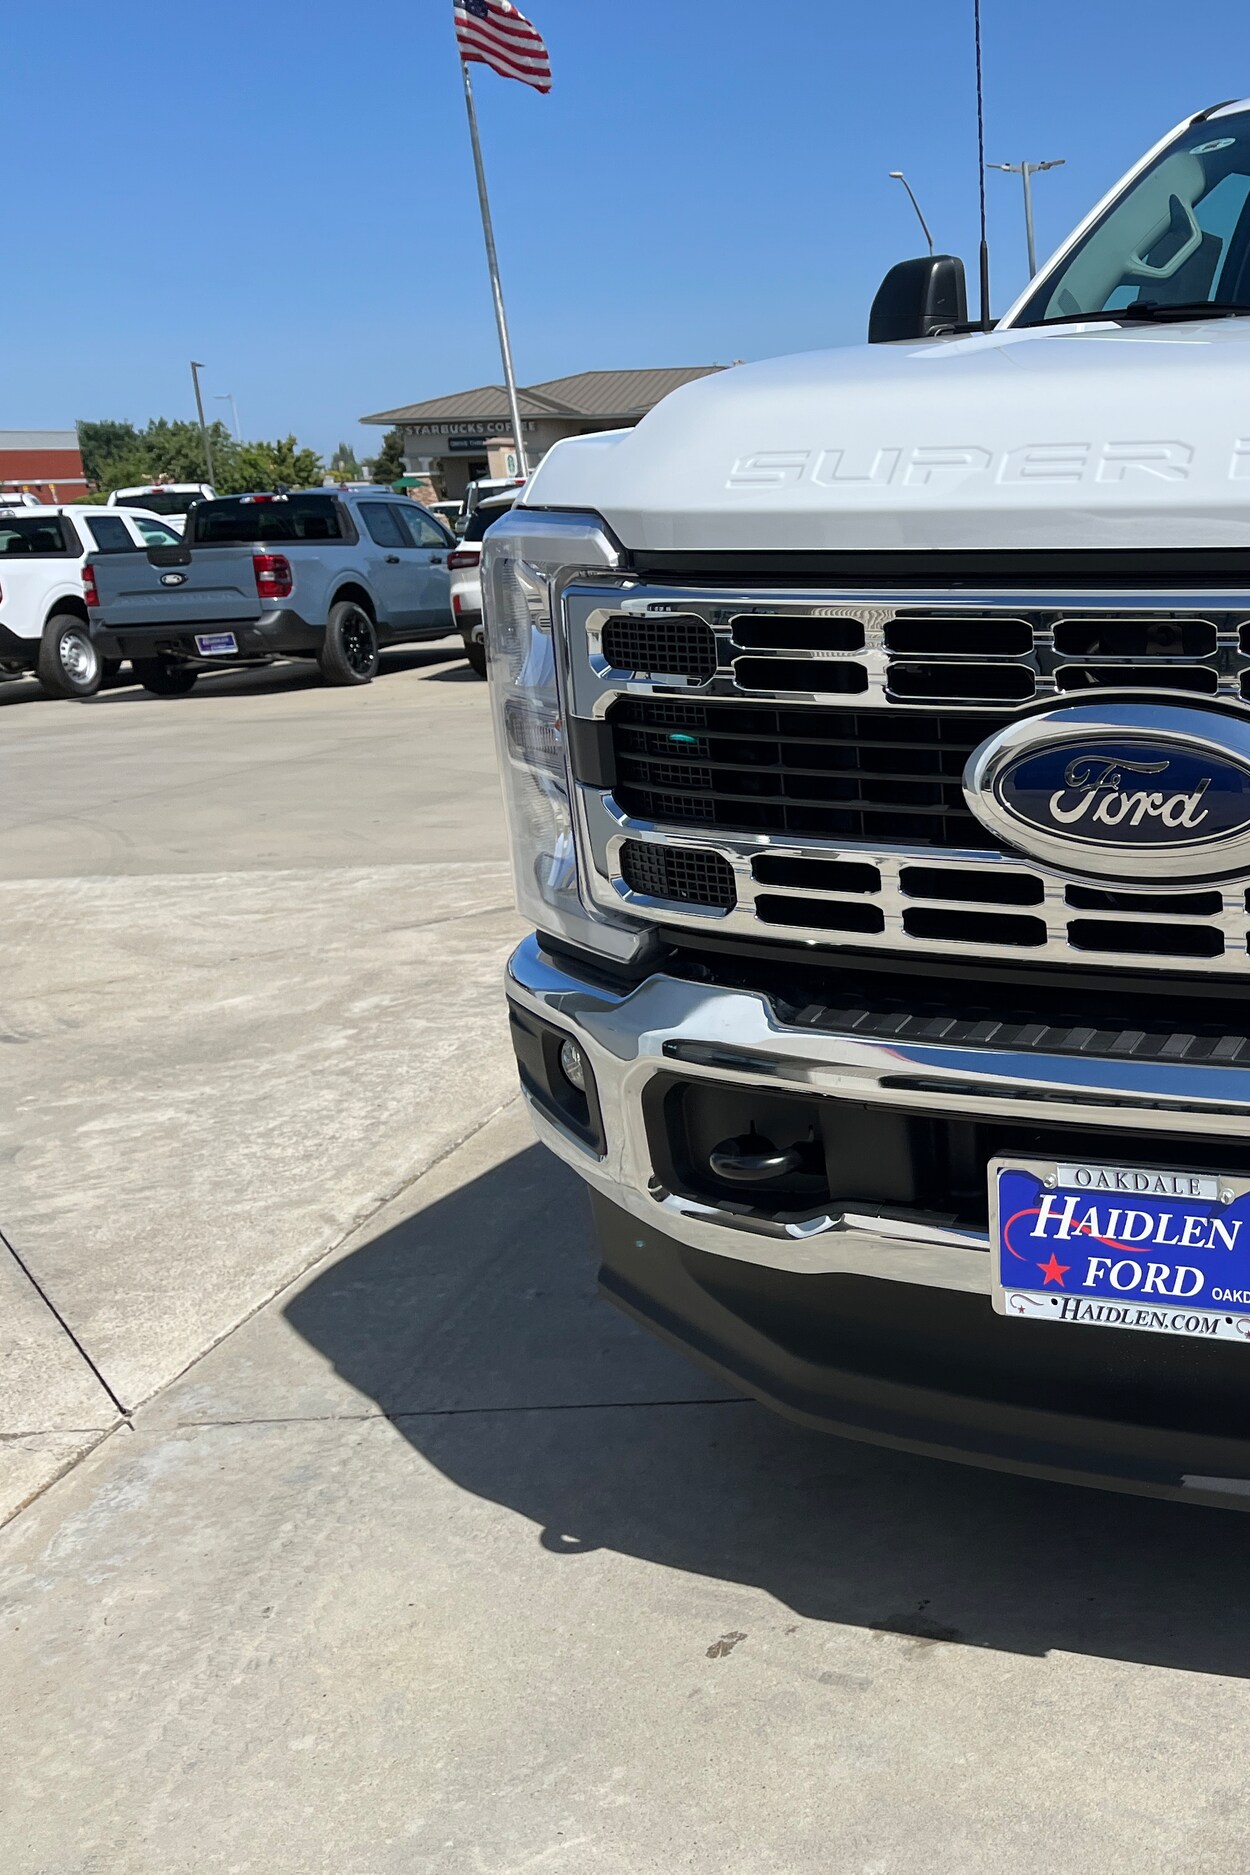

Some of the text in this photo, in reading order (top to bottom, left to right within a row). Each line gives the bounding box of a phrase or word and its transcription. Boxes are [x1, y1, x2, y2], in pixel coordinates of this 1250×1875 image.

[405, 421, 537, 436] STARBUCKS COFEE
[725, 439, 1196, 489] SUPER
[1050, 755, 1212, 829] Ford
[1074, 1168, 1202, 1196] OAKDALE
[1030, 1194, 1243, 1251] HAIDLEN
[1082, 1256, 1206, 1298] FORD
[1059, 1297, 1222, 1335] HAIDLEN.COM
